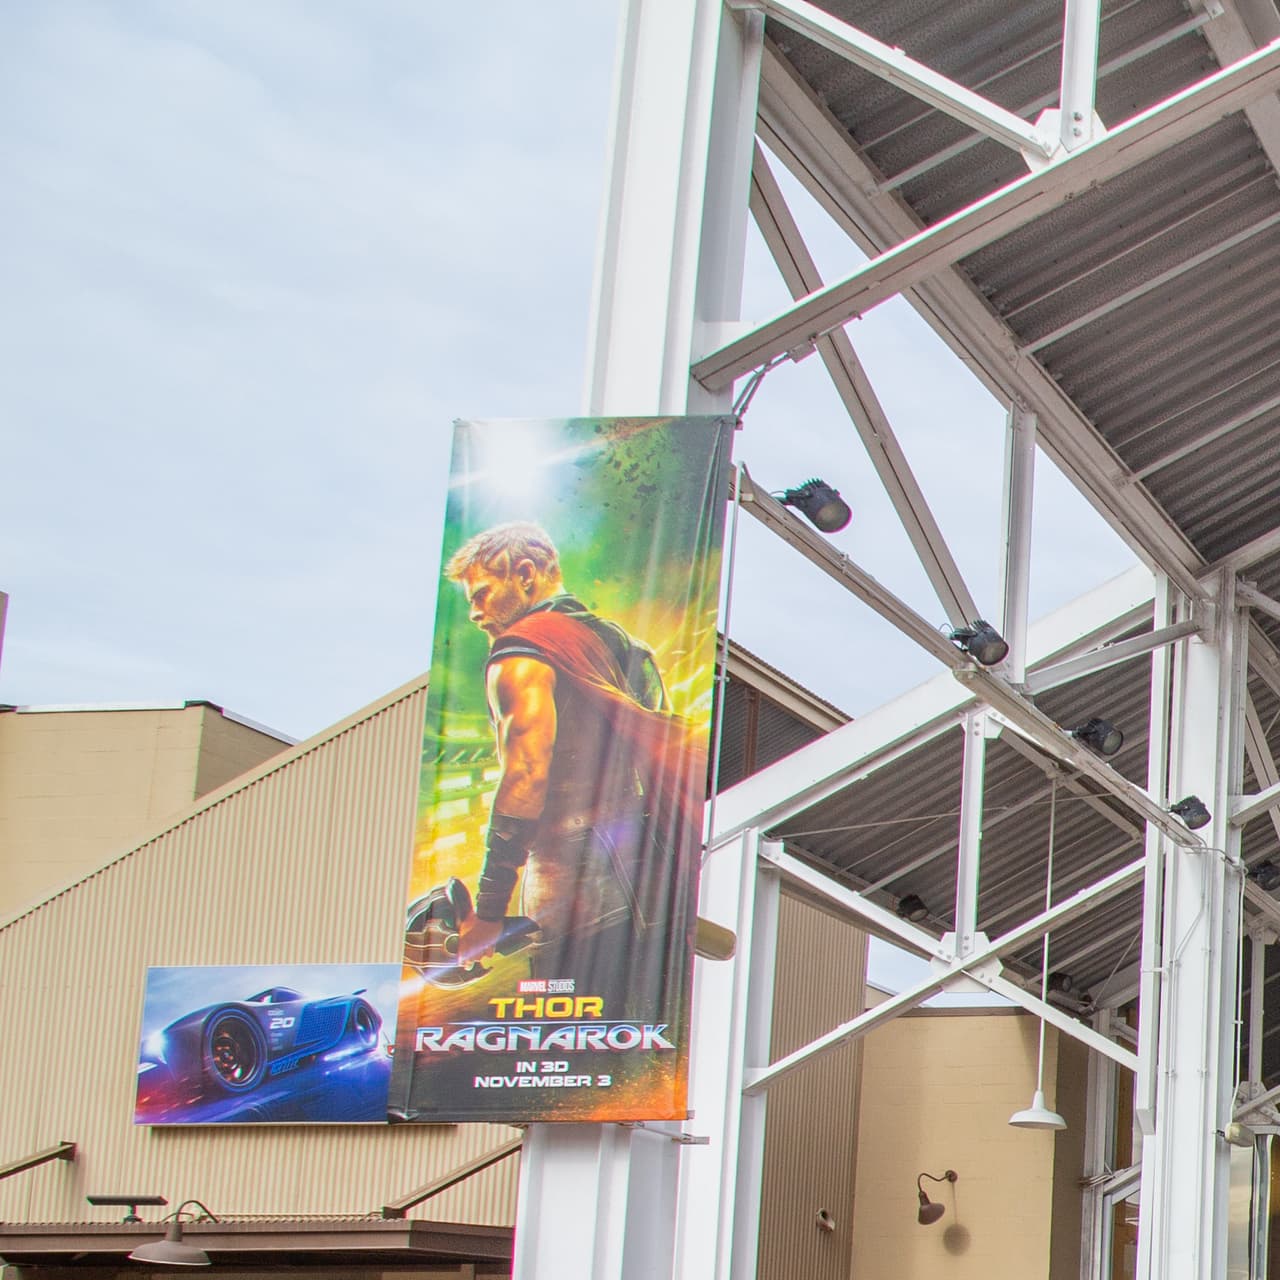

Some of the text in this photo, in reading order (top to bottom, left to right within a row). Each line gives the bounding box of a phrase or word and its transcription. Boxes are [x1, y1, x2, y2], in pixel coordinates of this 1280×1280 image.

[519, 980, 575, 993] MARVEL STUDIOS
[488, 996, 604, 1018] THOR
[270, 1017, 296, 1029] 20
[415, 1024, 676, 1052] RAGNAROK
[516, 1061, 568, 1073] IN 3D
[474, 1075, 612, 1088] NOVEMBER 3
